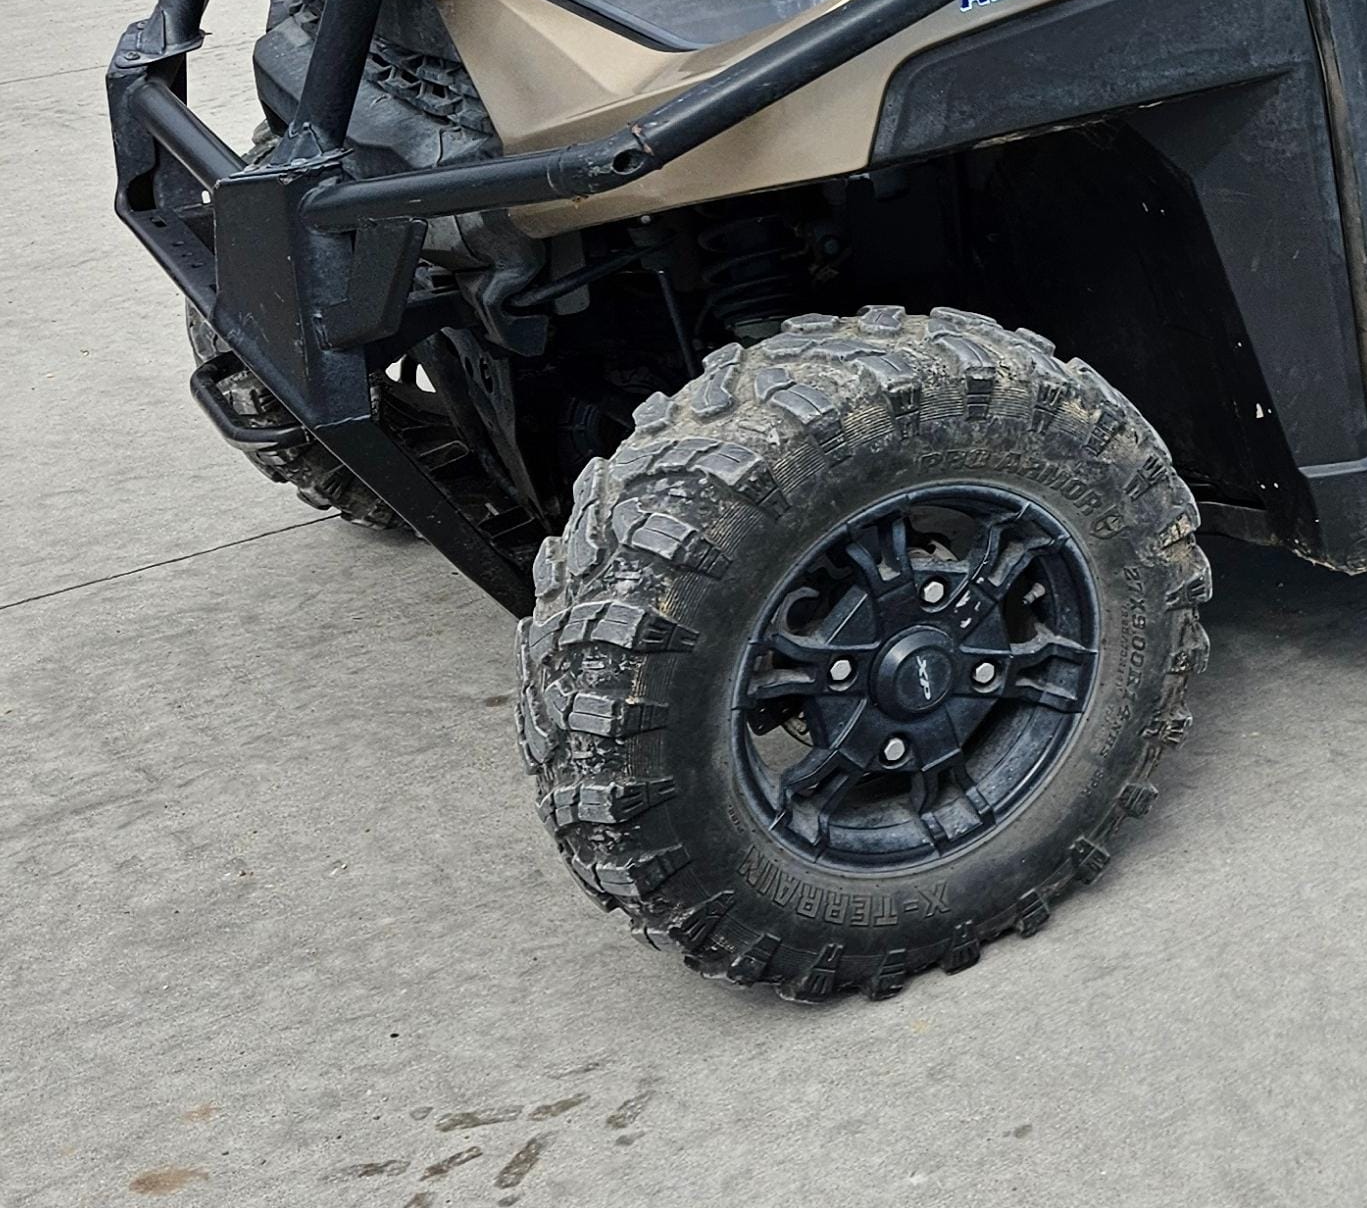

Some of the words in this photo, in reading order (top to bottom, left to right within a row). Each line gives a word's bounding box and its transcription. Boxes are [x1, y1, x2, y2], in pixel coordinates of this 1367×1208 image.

[996, 450, 1105, 517] ARMOR
[916, 655, 932, 701] XP
[735, 843, 952, 929] X-TERRAIN
